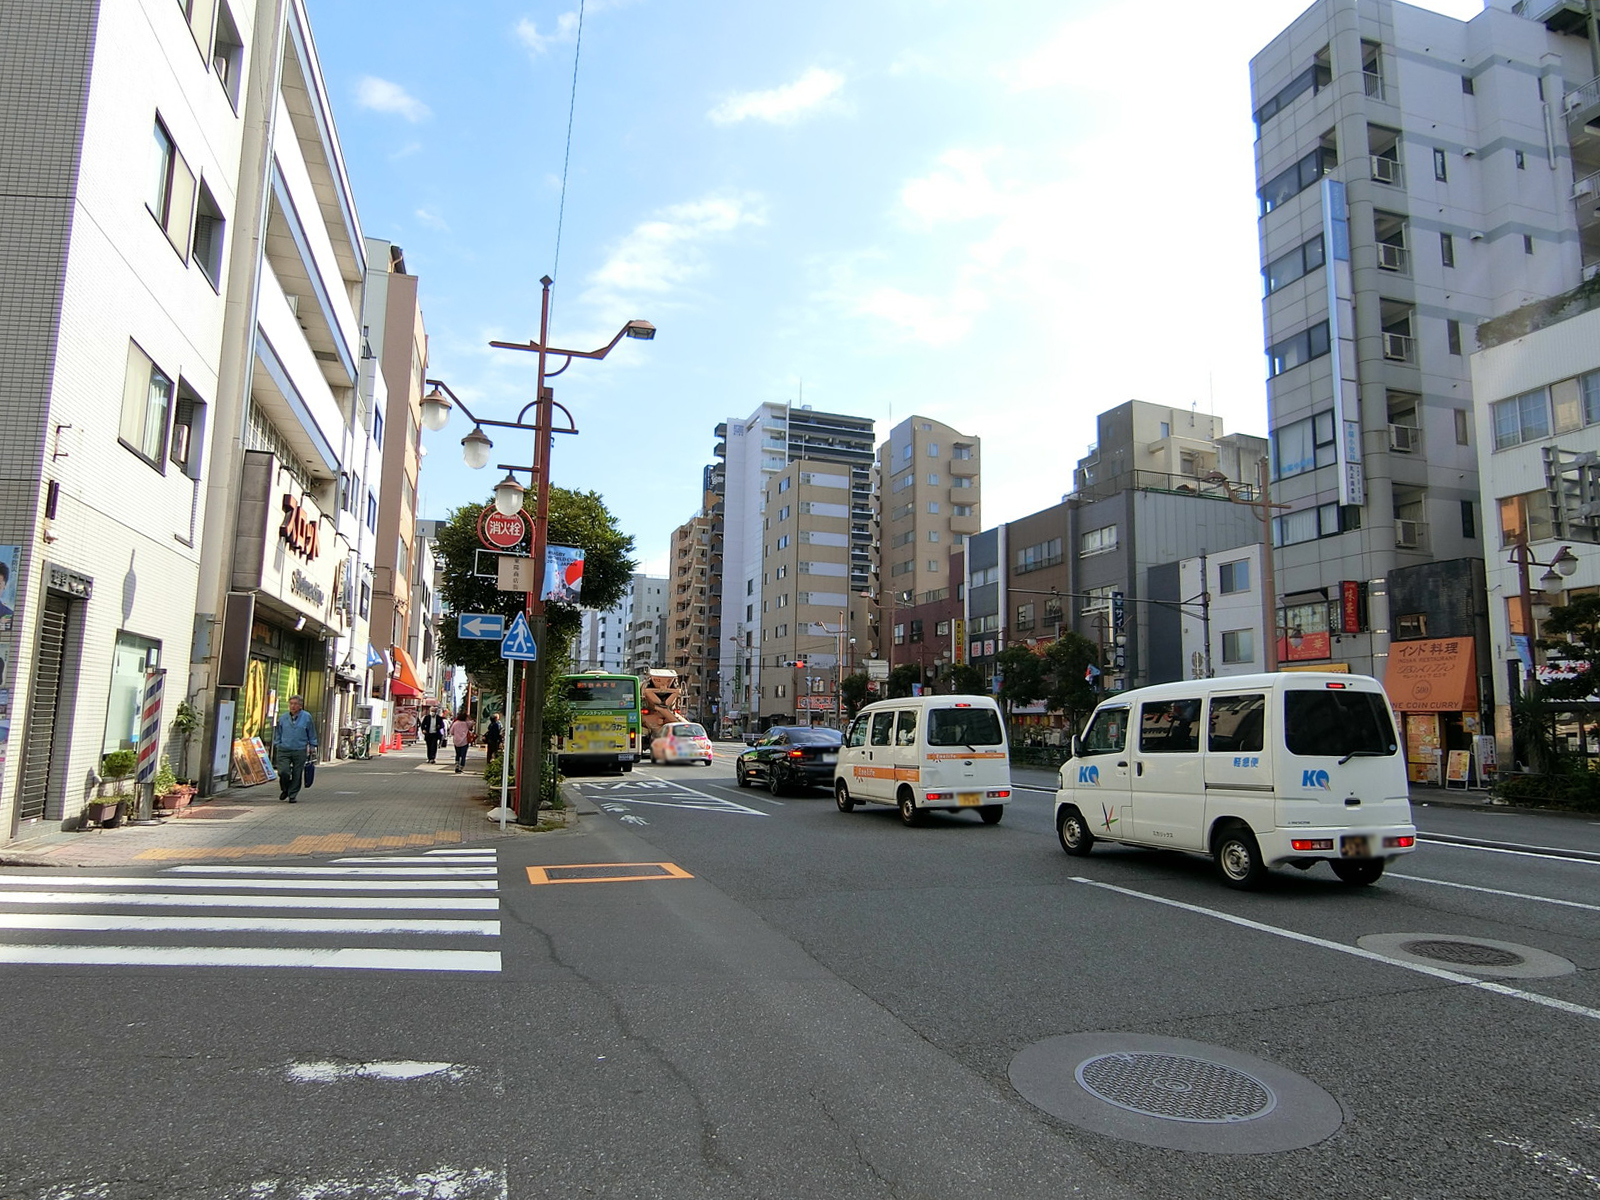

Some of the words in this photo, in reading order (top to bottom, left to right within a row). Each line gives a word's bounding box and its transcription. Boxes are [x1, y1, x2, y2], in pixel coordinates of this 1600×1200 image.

[279, 494, 320, 564] スロット
[489, 520, 522, 536] 消火栓
[1430, 701, 1459, 709] CURRY
[1233, 757, 1259, 768] 軽急便
